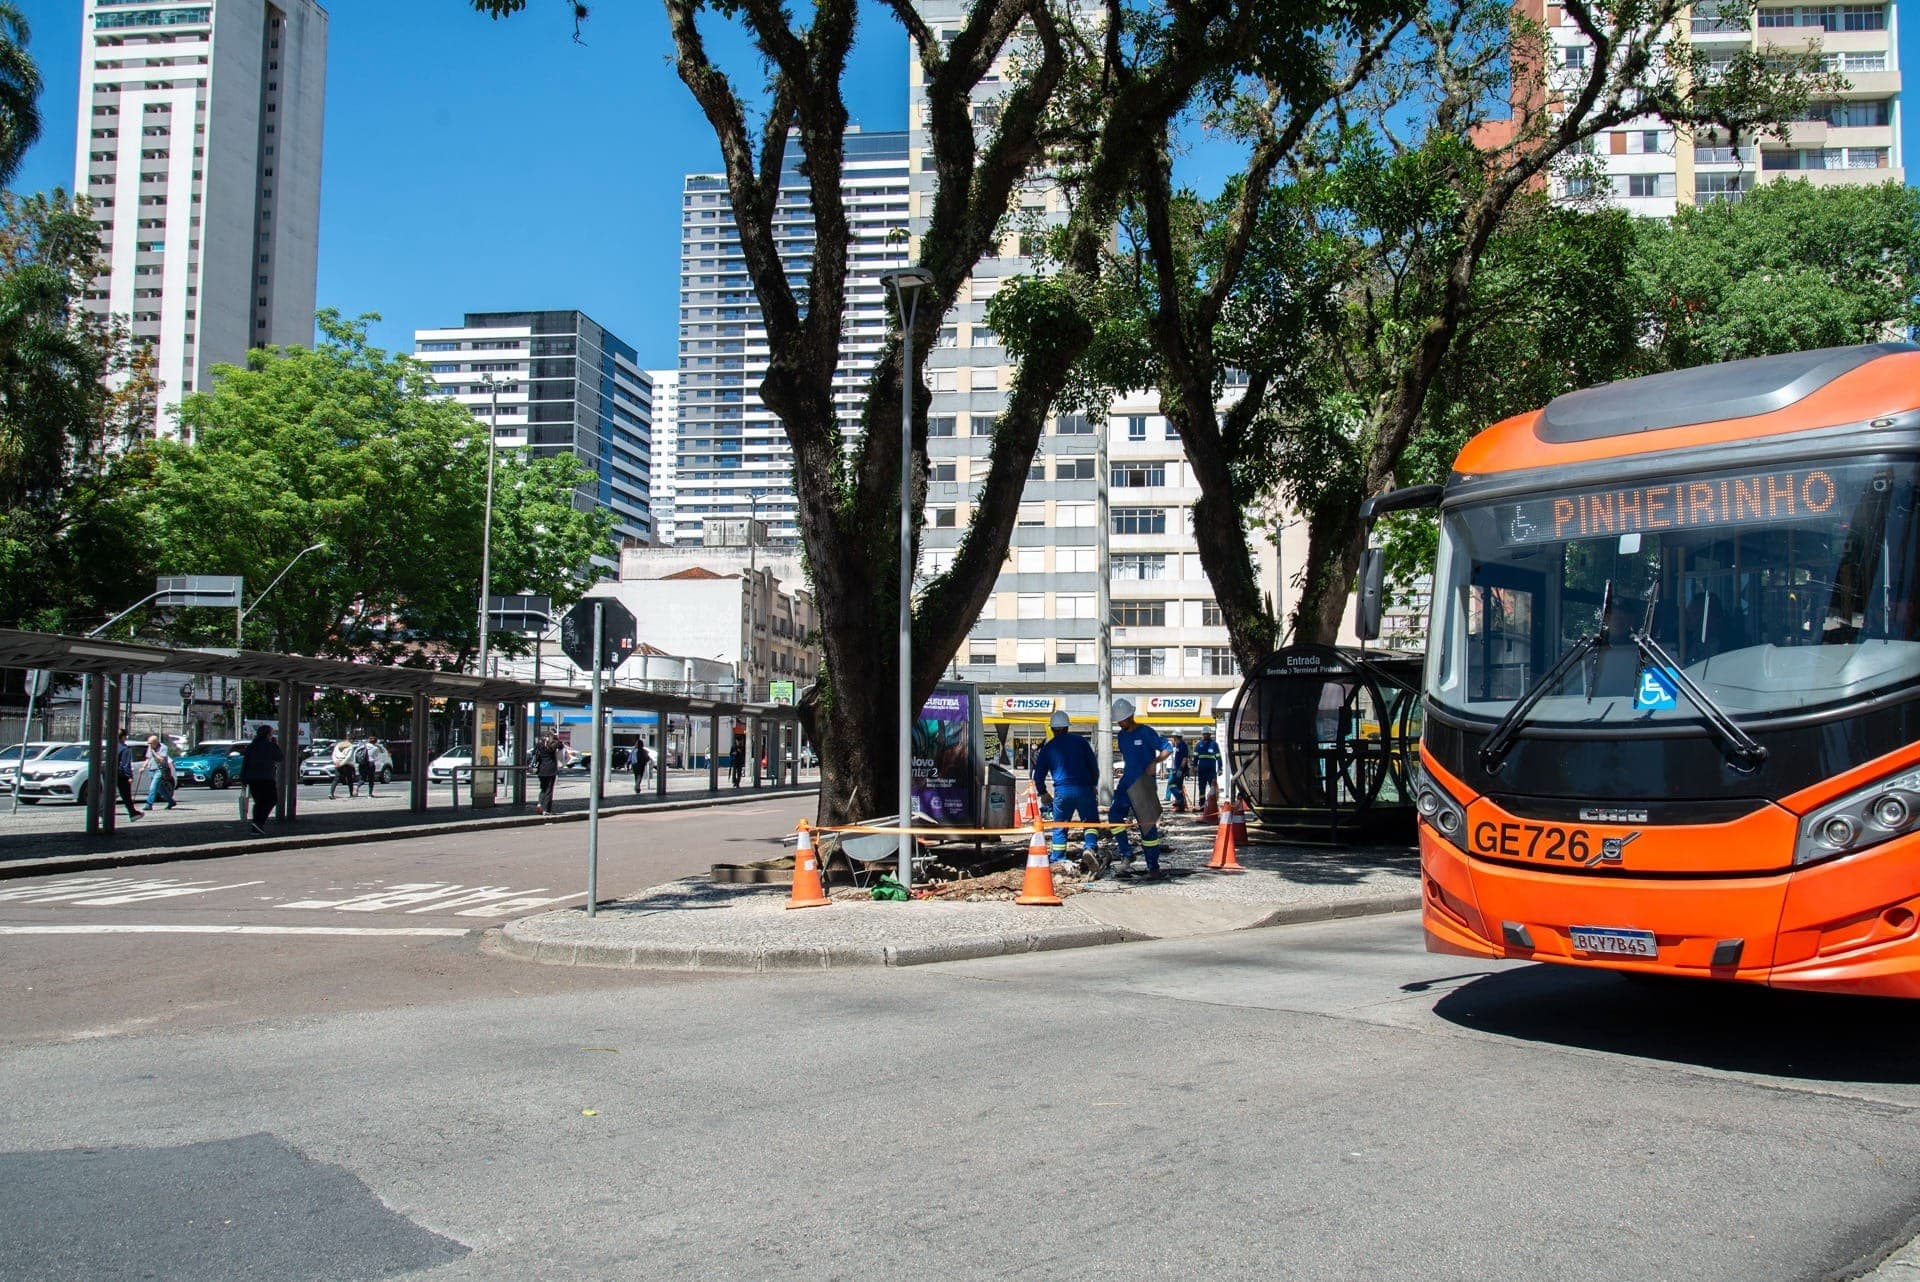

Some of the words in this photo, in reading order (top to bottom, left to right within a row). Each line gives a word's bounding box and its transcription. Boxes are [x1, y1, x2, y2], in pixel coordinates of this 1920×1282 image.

[1553, 471, 1835, 537] PINHEIRINHO
[1286, 655, 1320, 665] Entrada
[1017, 698, 1050, 708] nissei
[1162, 697, 1196, 708] nissei
[1474, 821, 1590, 863] GE726
[1577, 934, 1648, 954] BCY7B45
